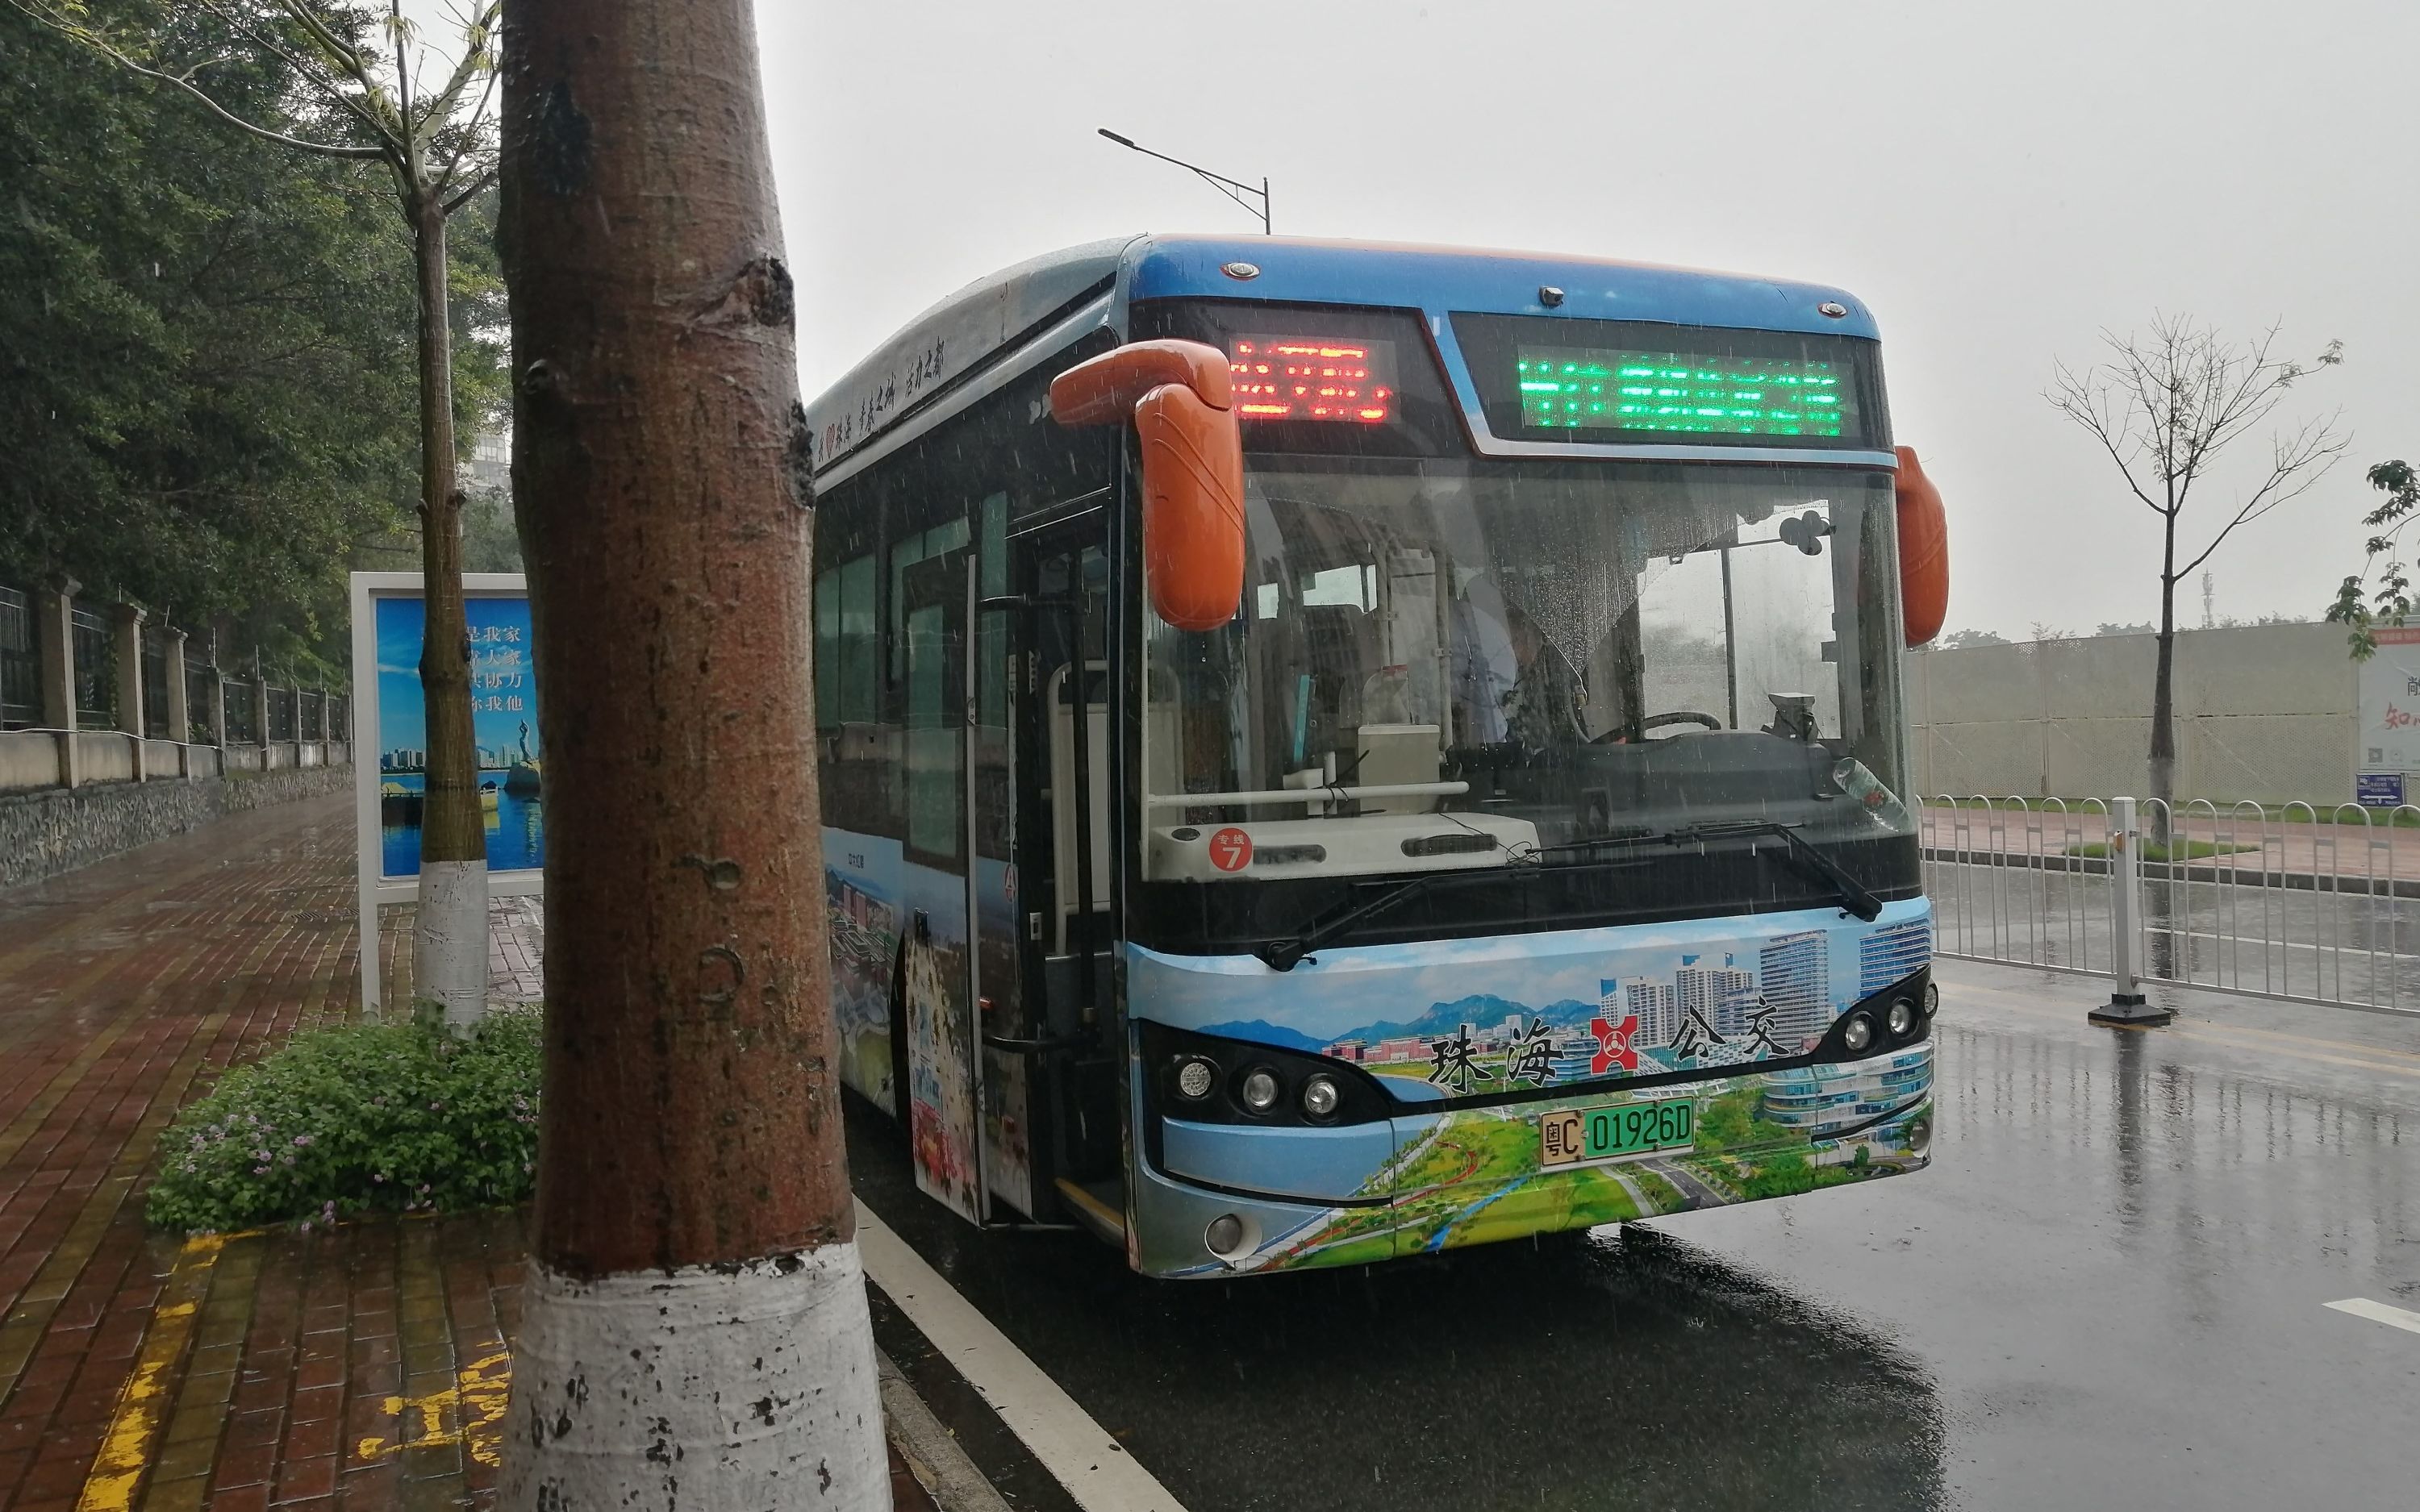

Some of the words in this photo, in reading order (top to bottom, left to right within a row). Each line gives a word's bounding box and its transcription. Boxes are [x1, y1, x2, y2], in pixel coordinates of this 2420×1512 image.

[1217, 834, 1245, 845] 专线
[1222, 847, 1241, 868] 7
[1427, 1017, 1565, 1094] 珠海
[1668, 995, 1791, 1062] 公交
